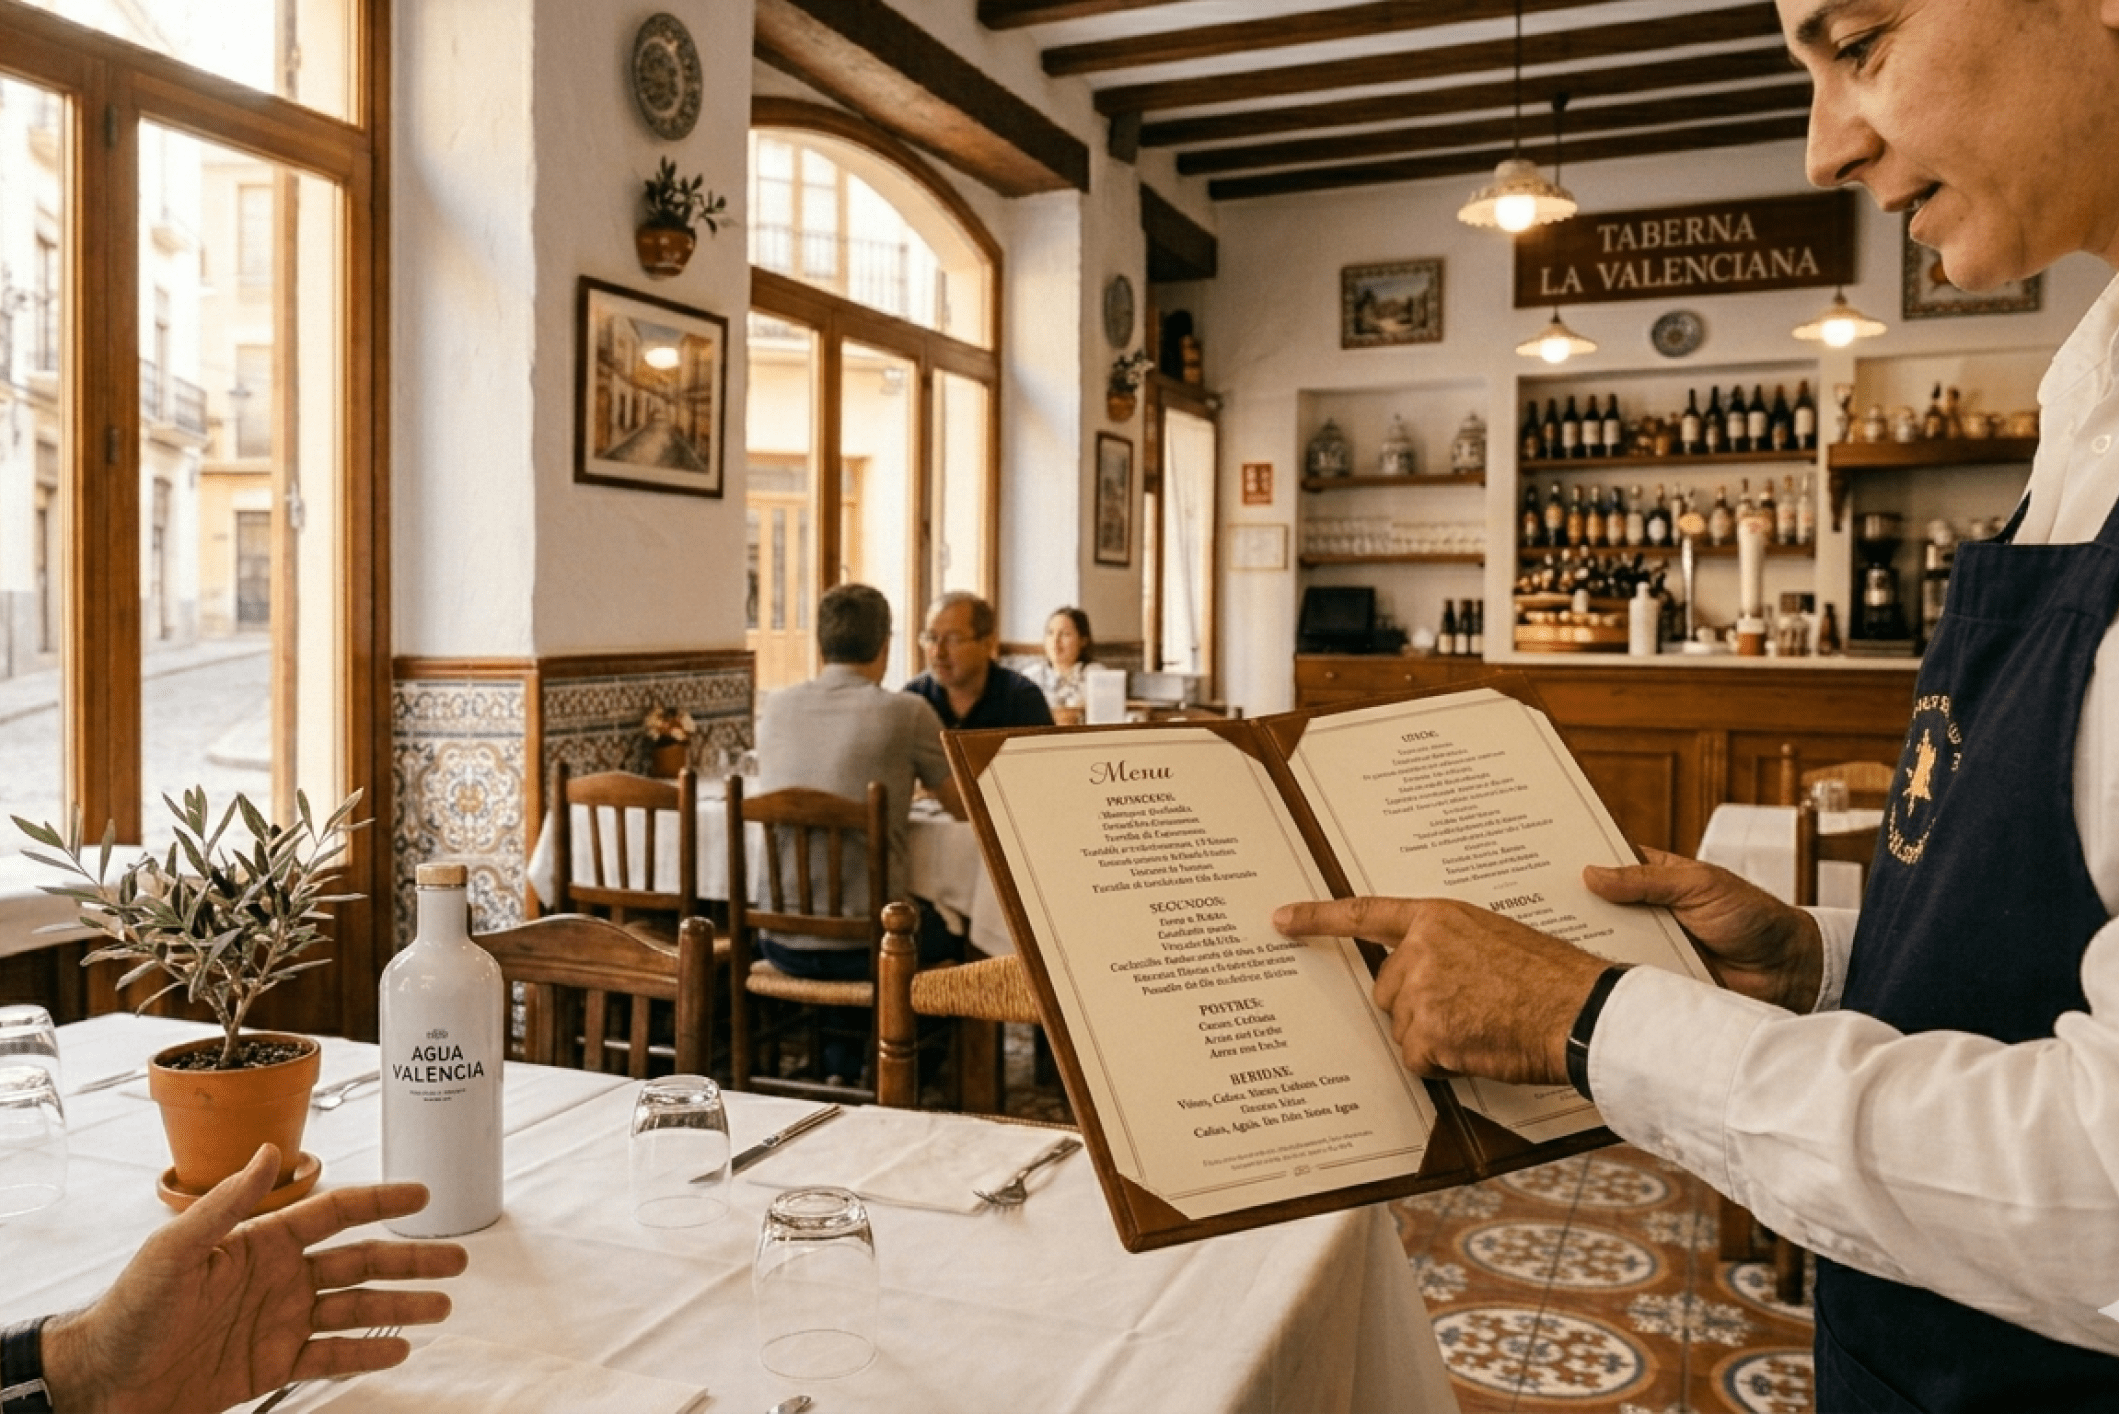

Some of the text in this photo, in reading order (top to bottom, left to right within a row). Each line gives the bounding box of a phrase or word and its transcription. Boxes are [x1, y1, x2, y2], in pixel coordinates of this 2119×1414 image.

[1597, 212, 1757, 252] TABERNA
[1540, 247, 1820, 295] LA VALENCIANA
[1089, 760, 1174, 784] Menu
[411, 1044, 463, 1062] AGUA
[392, 1060, 485, 1083] VALENCIA
